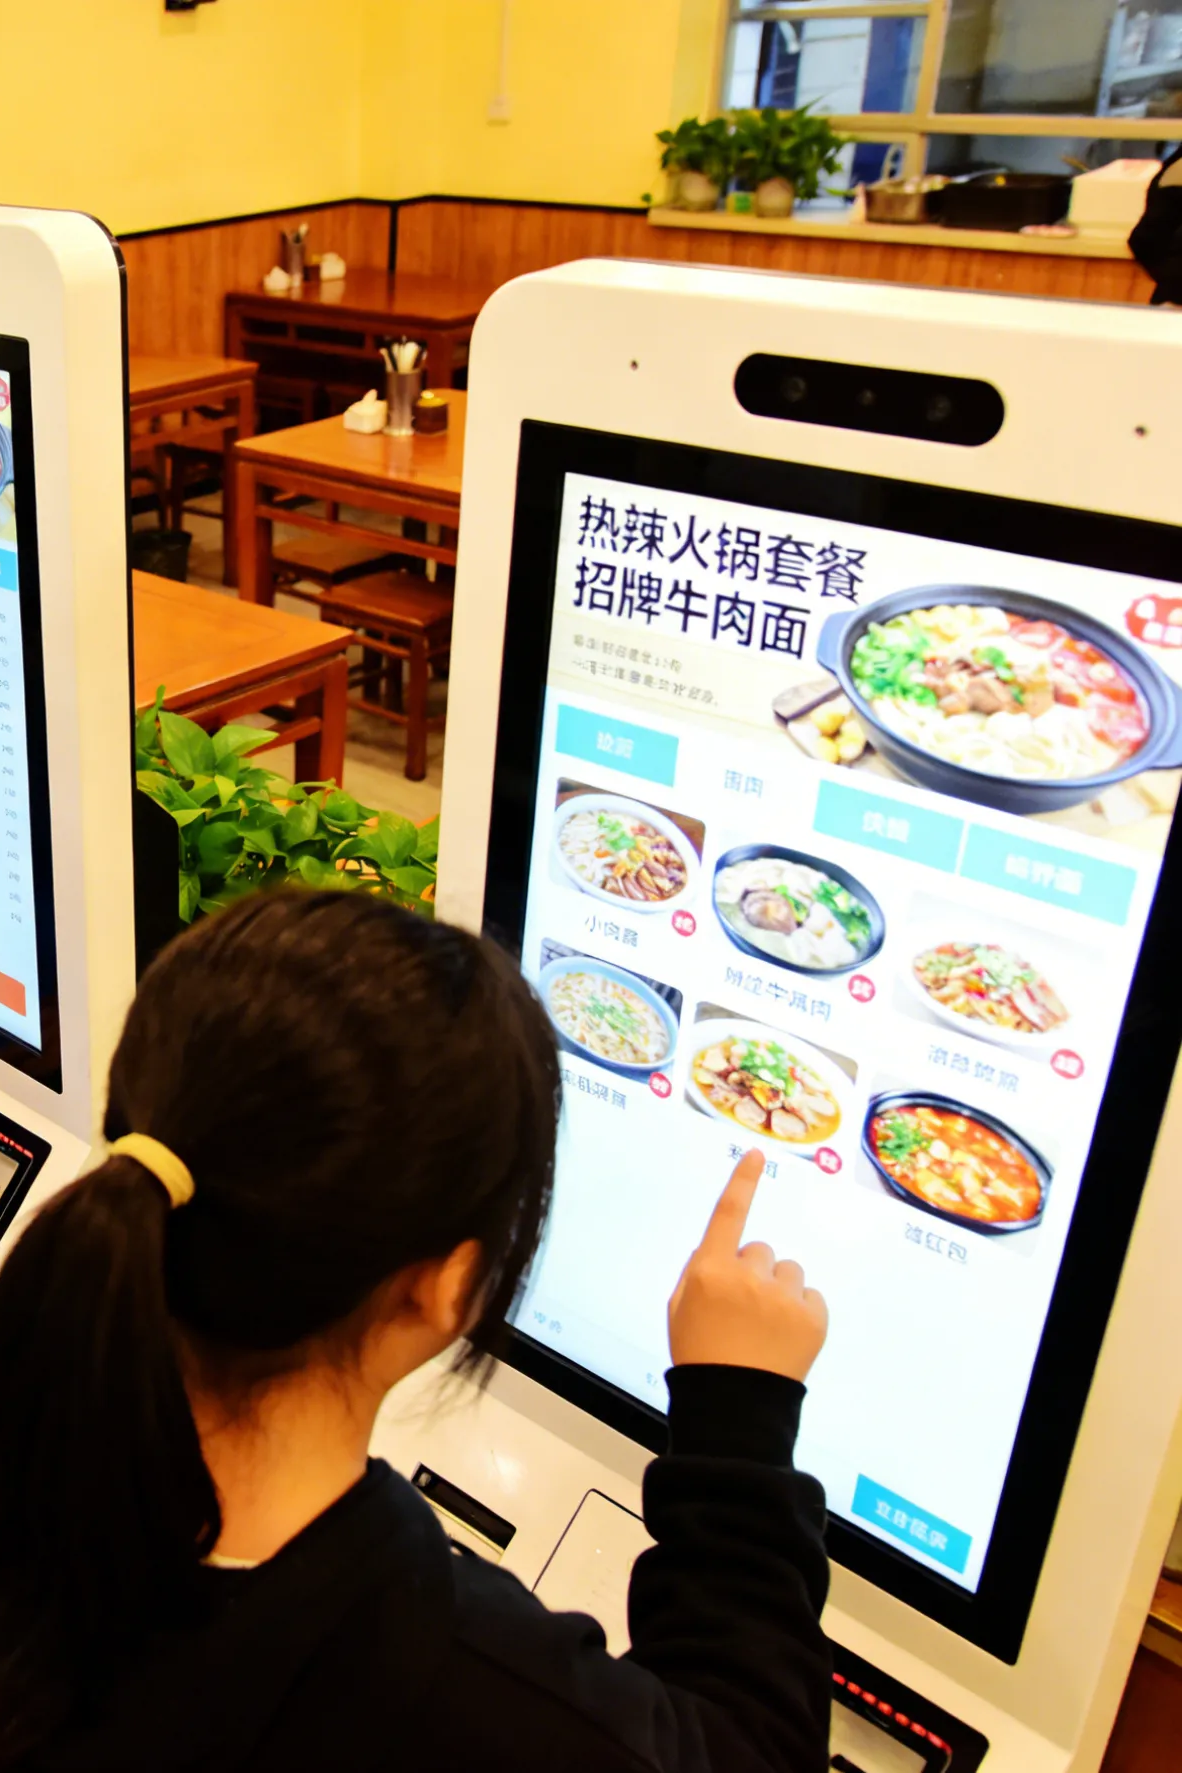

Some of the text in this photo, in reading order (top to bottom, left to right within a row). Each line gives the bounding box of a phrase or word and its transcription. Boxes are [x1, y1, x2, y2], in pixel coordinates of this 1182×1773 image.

[578, 494, 868, 605] 热辣火锅套餐
[573, 556, 812, 660] 招牌牛肉面
